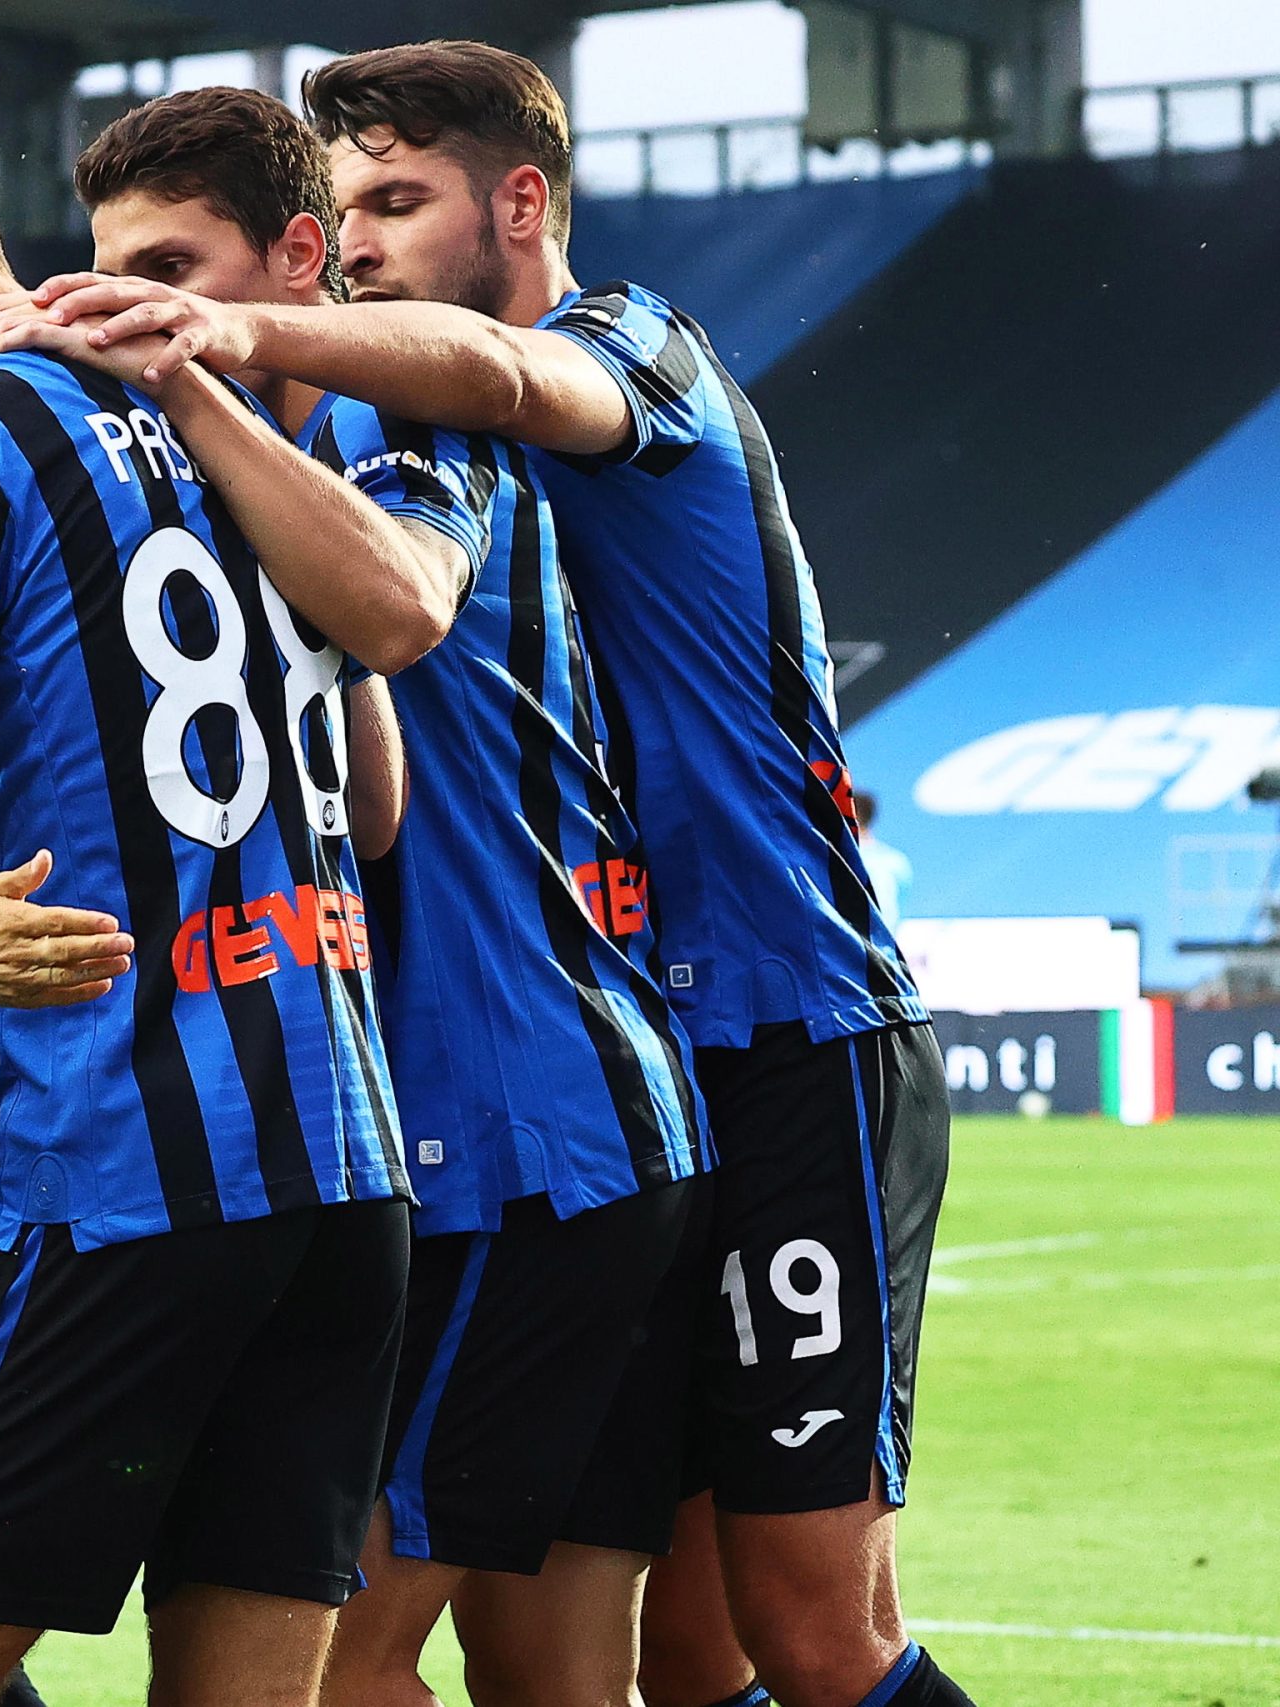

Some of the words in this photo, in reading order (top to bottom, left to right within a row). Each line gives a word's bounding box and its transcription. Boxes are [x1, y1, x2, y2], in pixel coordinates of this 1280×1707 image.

[84, 408, 207, 483] PAS
[123, 526, 350, 849] 88
[720, 1238, 842, 1367] 19
